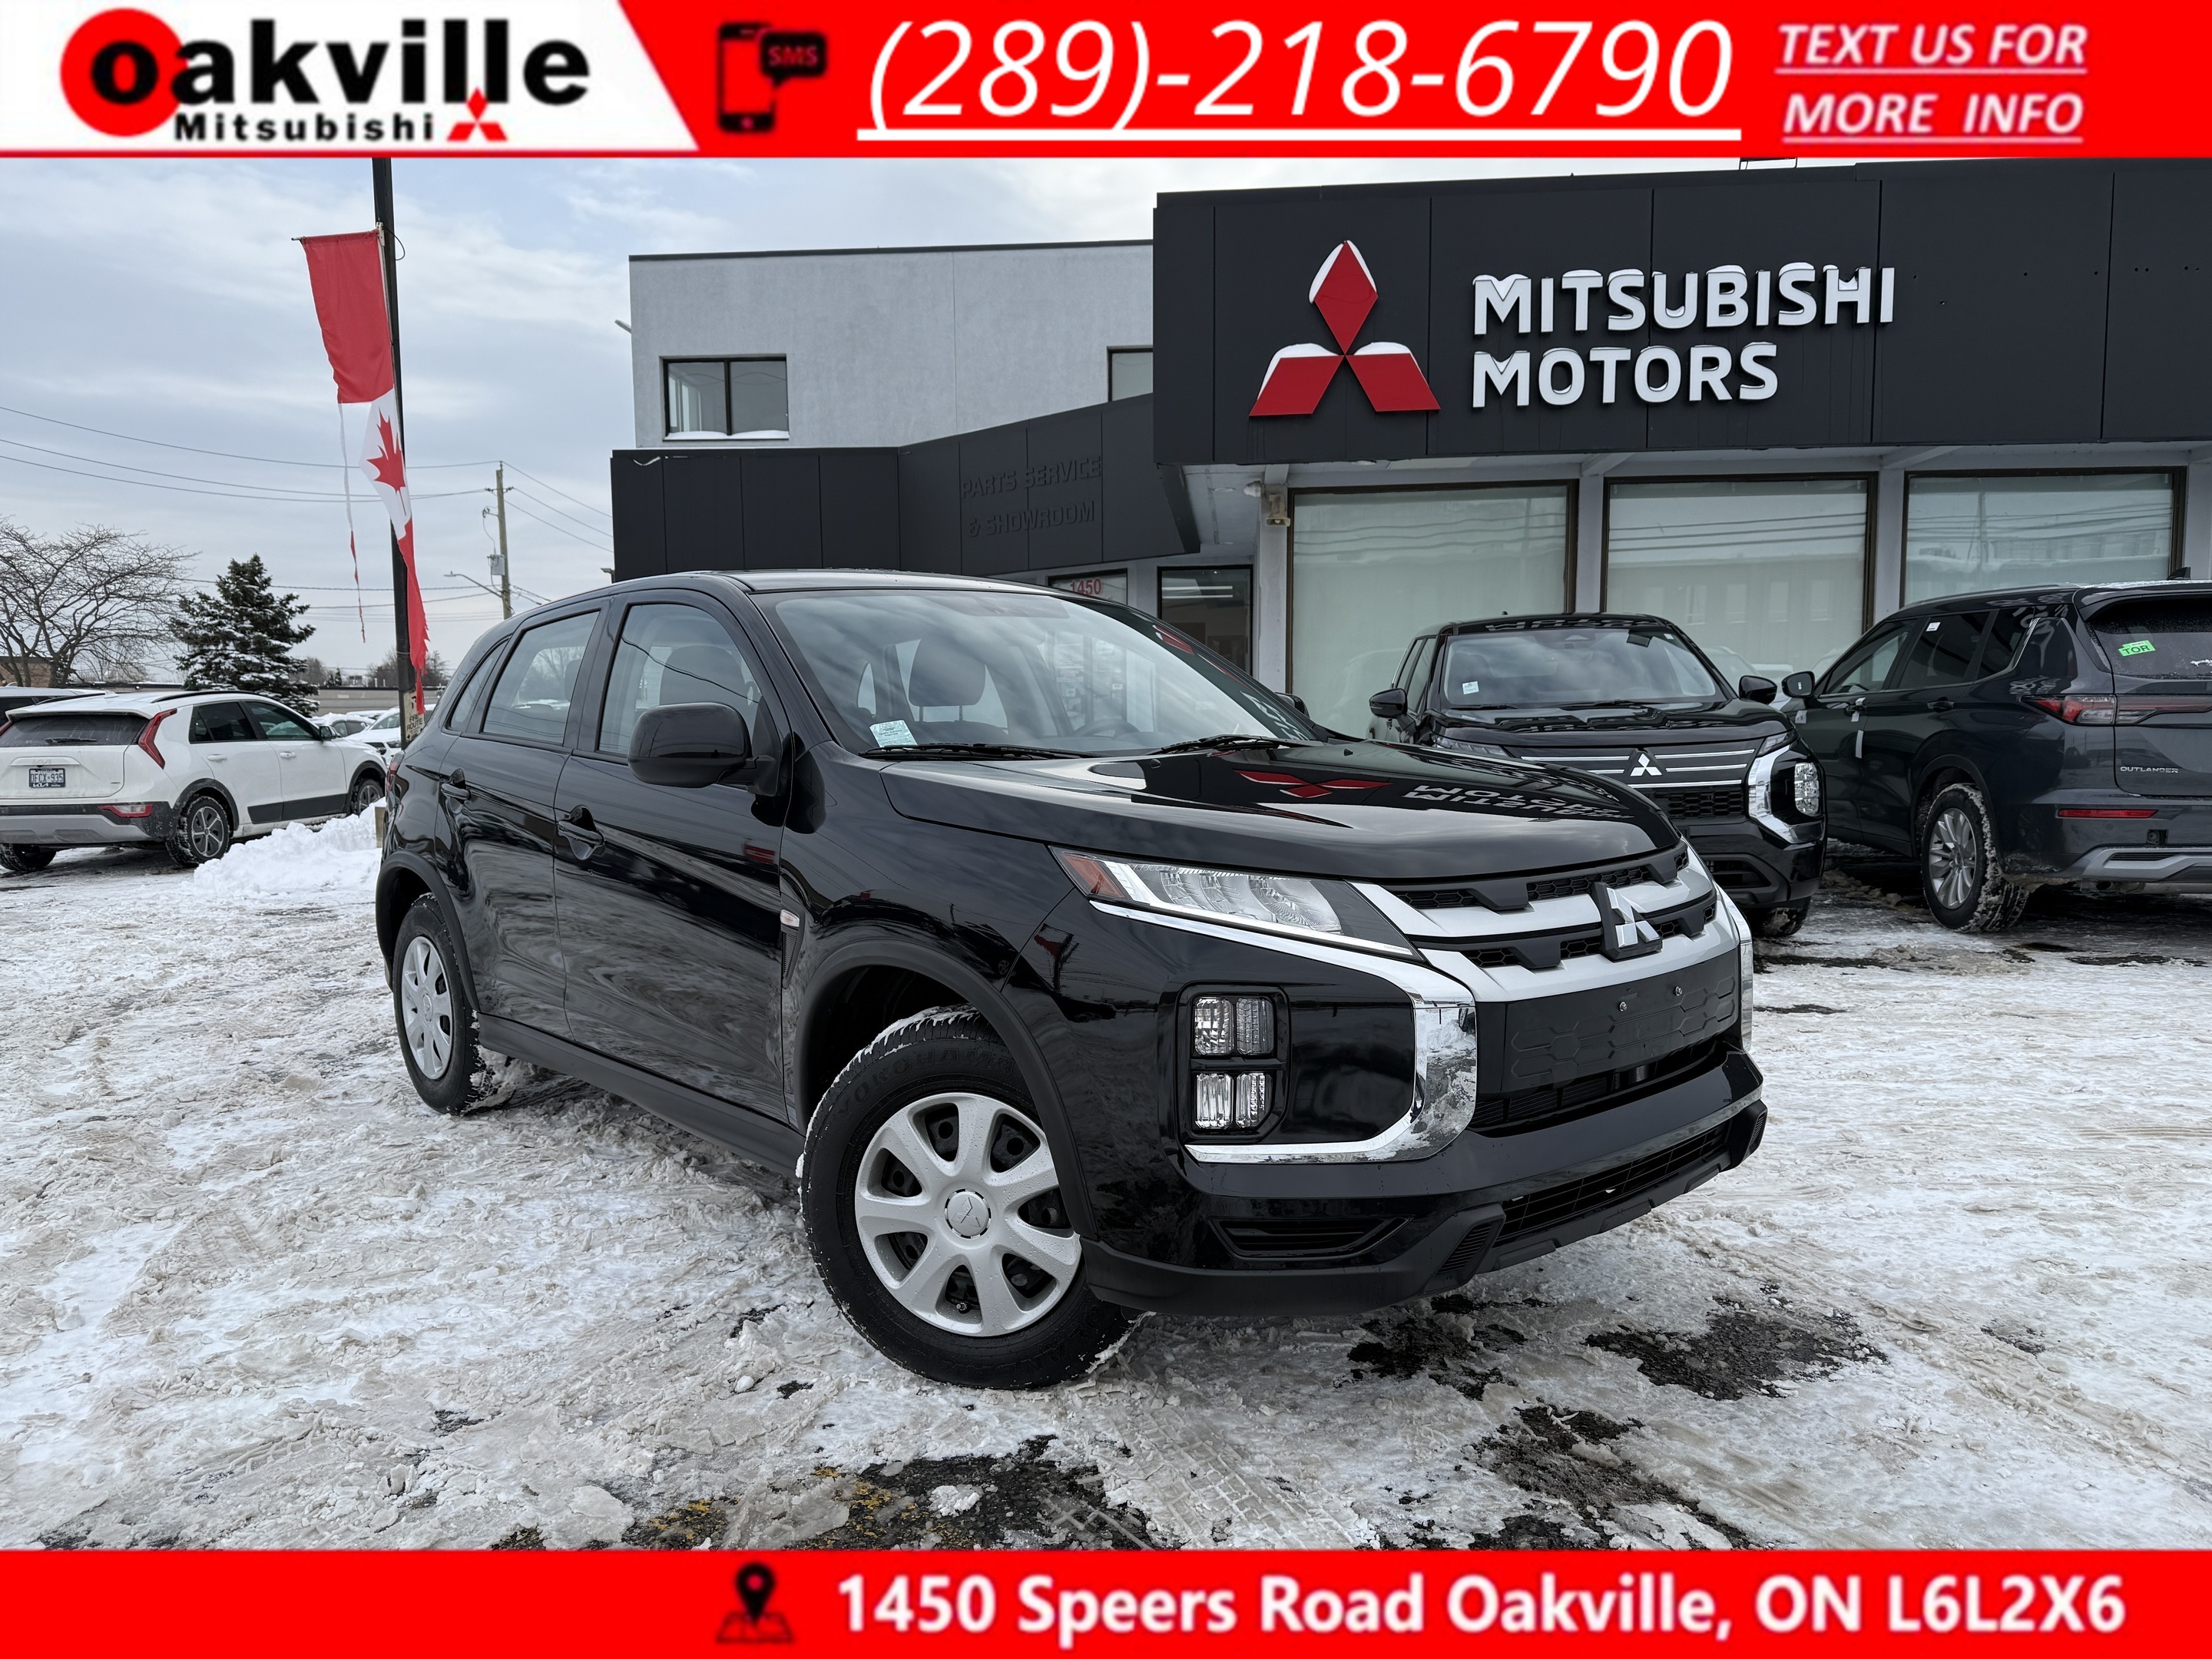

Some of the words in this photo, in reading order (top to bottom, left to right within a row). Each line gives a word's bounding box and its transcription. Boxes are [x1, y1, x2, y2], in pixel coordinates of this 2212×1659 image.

[1473, 266, 1895, 336] MITSUBISHI
[1472, 343, 1778, 409] MOTORS
[962, 470, 1018, 498] PARTS
[1025, 455, 1101, 489] SERVICE
[986, 500, 1094, 535] SHOWROOM
[1071, 578, 1102, 595] 1450
[2122, 645, 2151, 654] TOR
[406, 717, 422, 732] ROUTE
[409, 714, 419, 723] FIRE
